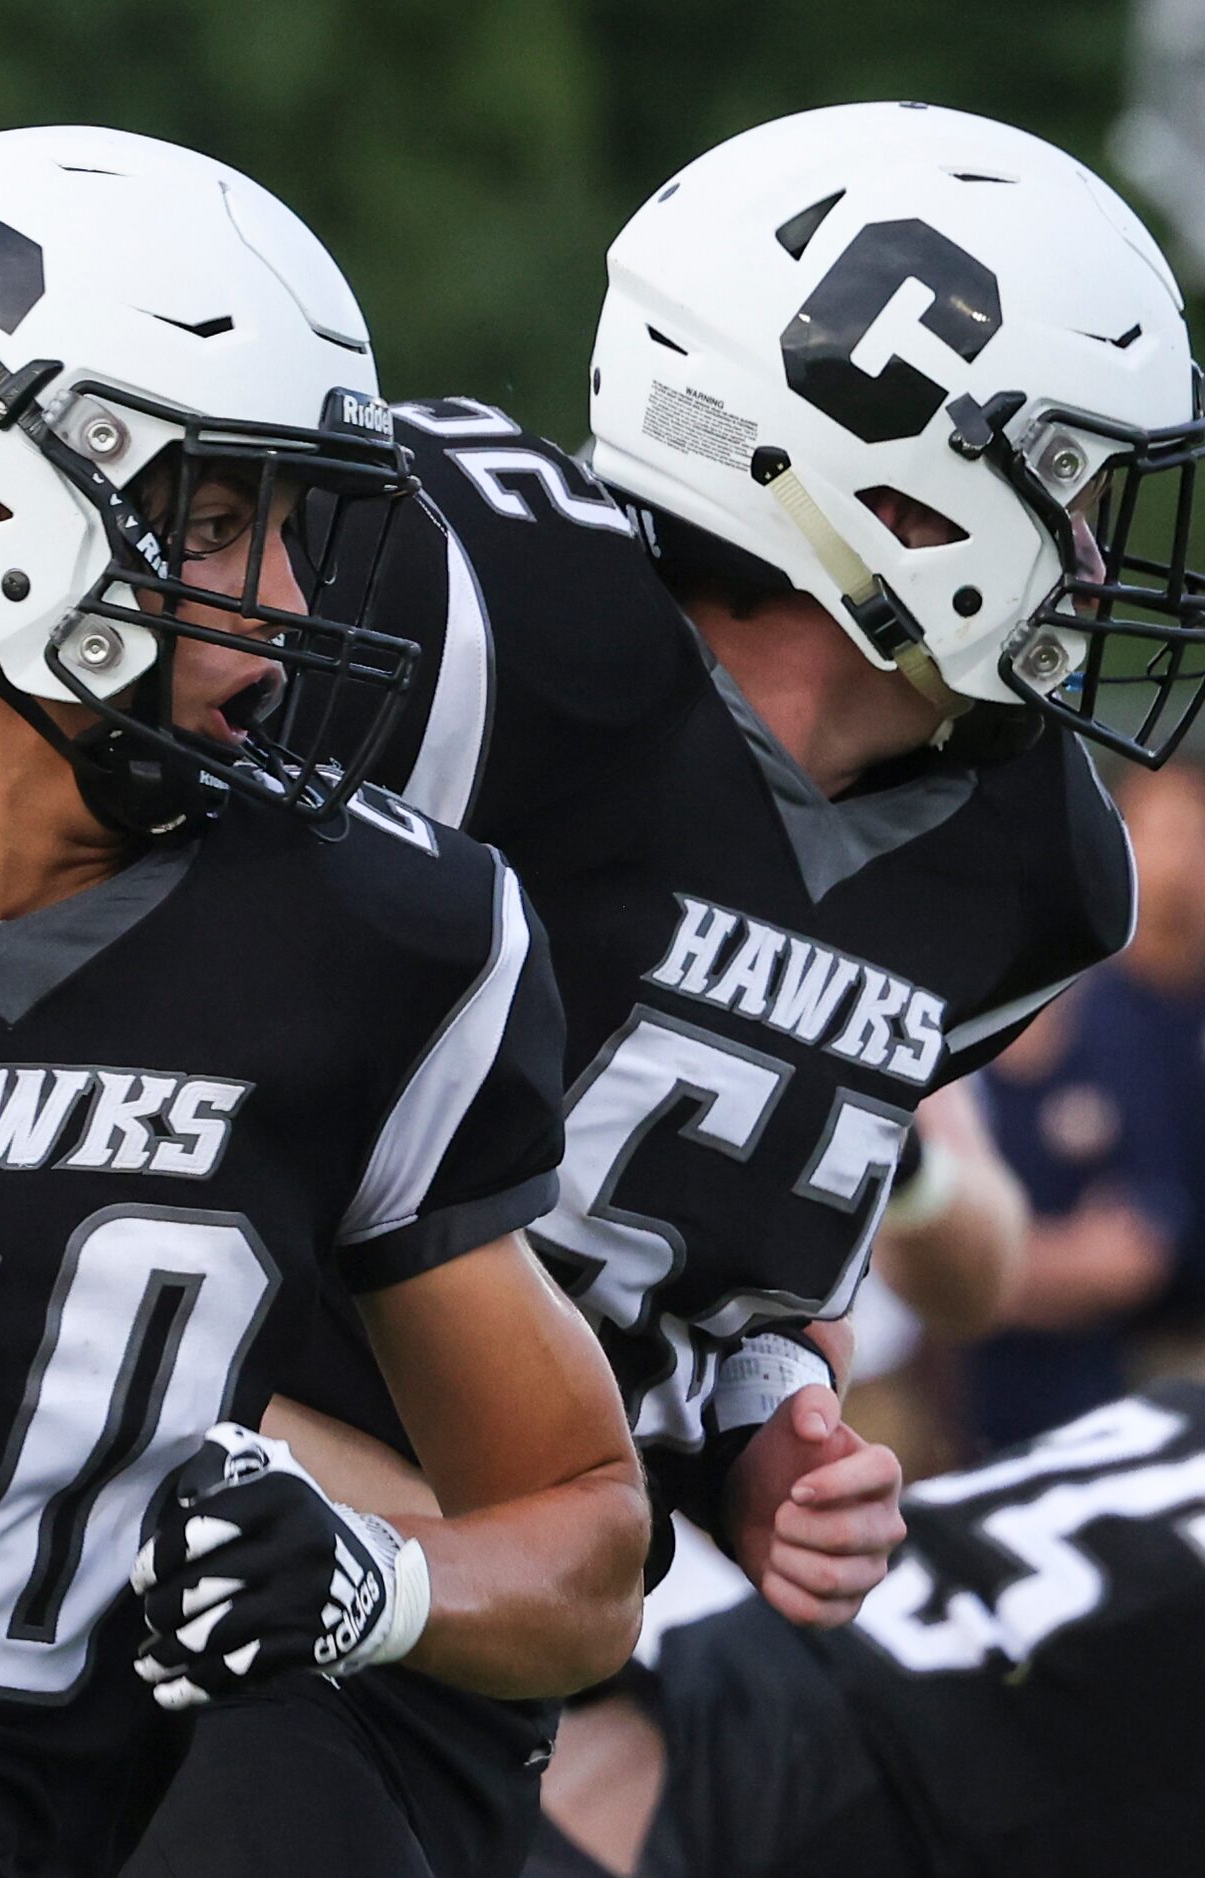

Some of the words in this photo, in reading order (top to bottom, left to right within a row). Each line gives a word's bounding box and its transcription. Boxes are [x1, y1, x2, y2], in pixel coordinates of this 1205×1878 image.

[686, 387, 724, 409] WARNING
[781, 217, 1003, 444] C
[642, 891, 948, 1085] HAWKS
[314, 1570, 380, 1665] adidas
